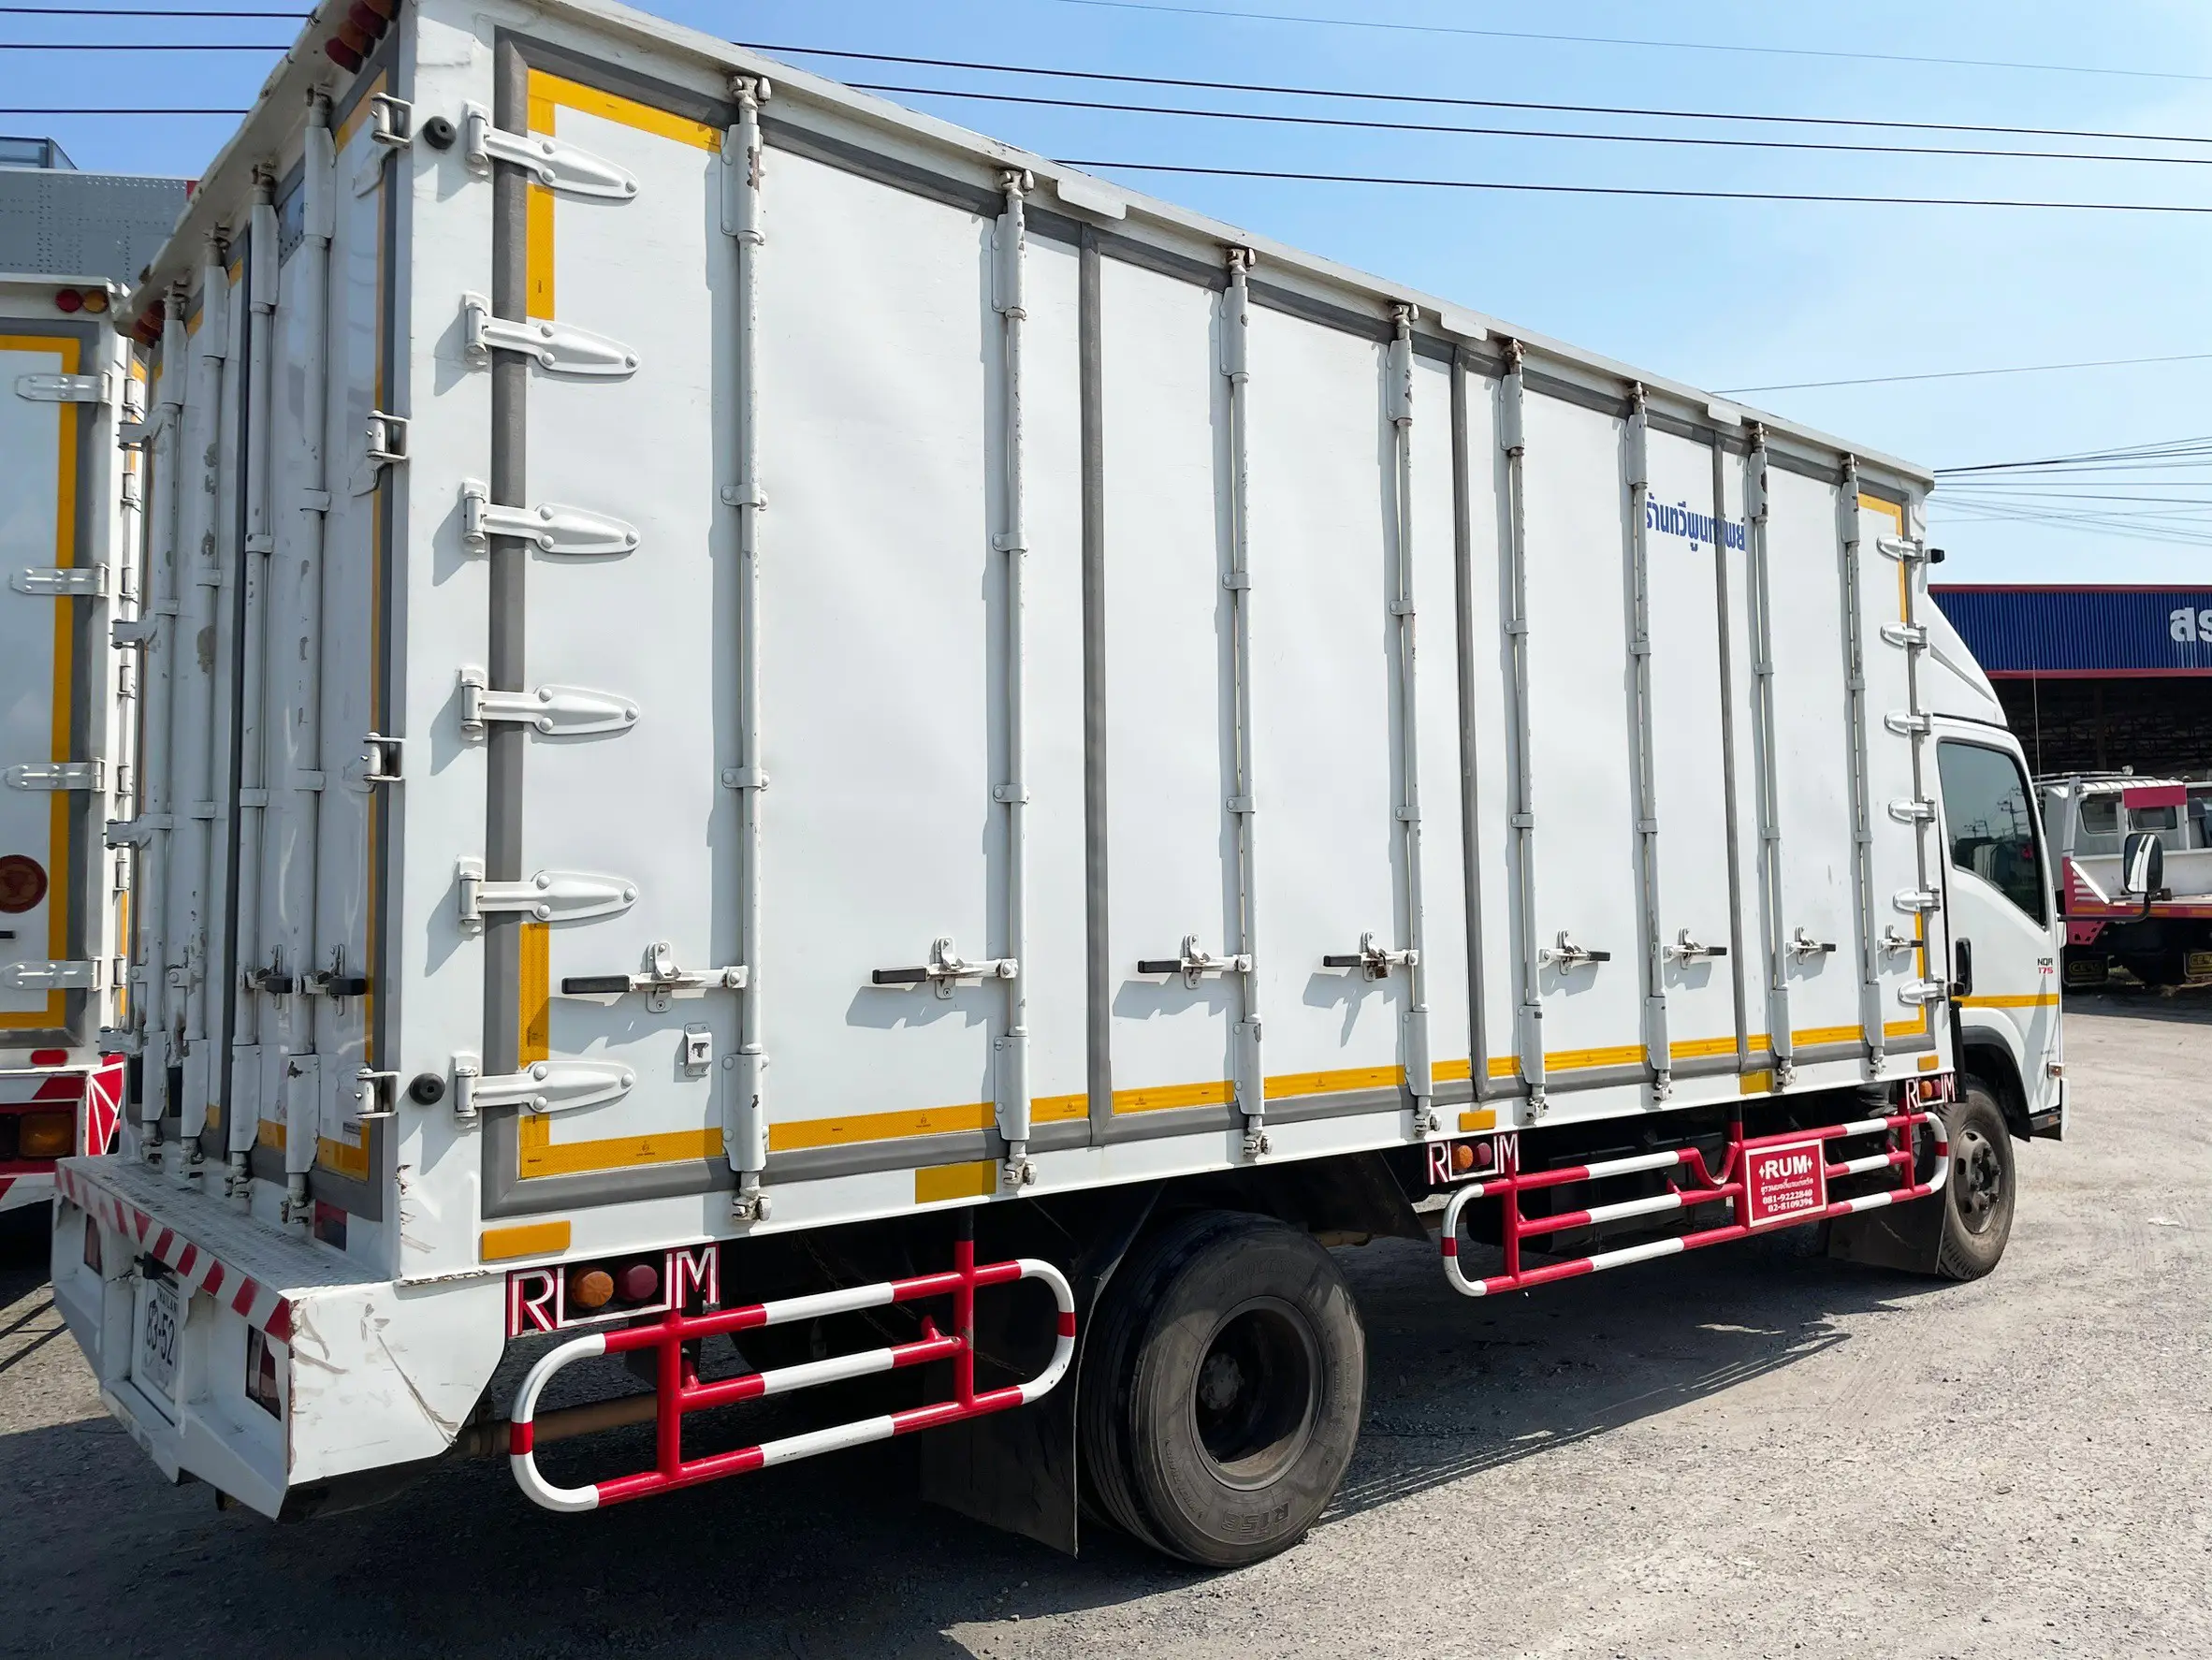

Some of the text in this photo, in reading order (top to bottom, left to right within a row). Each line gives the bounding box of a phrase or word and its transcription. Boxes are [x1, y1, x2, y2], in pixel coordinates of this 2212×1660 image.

[1765, 1155, 1808, 1180] RUM
[157, 1287, 178, 1313] THAILAN
[147, 1299, 175, 1366] 83-52
